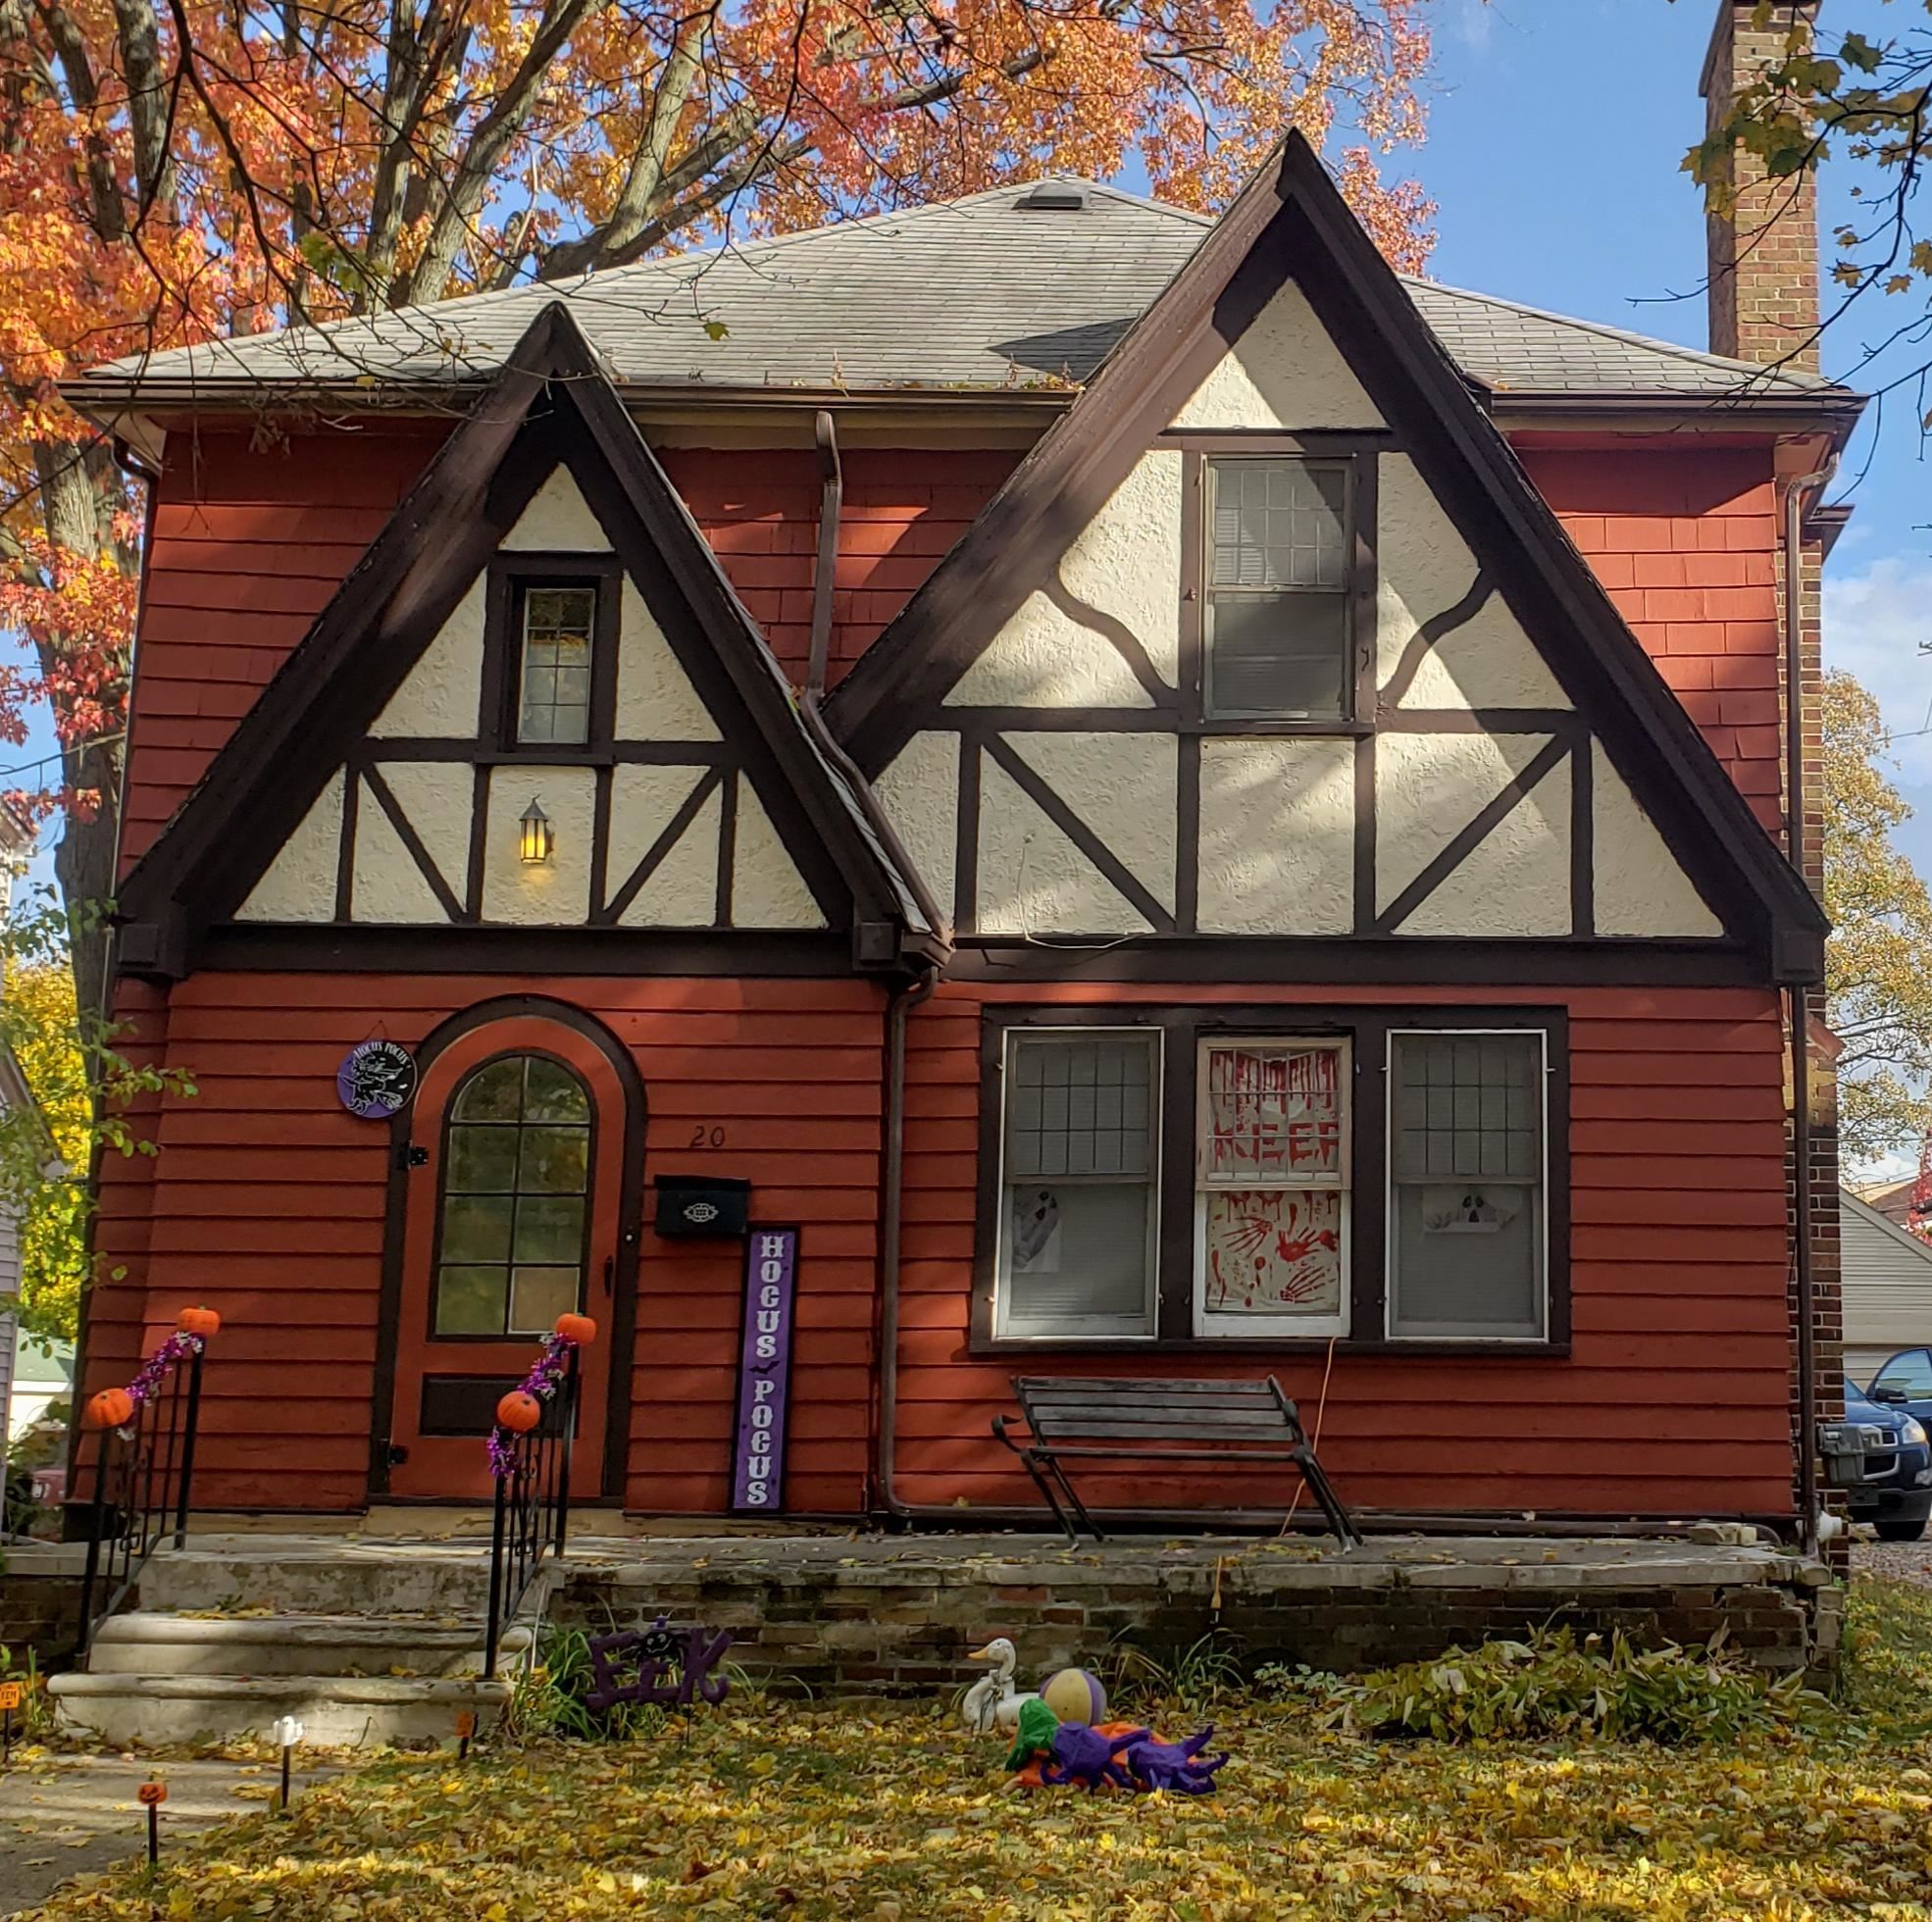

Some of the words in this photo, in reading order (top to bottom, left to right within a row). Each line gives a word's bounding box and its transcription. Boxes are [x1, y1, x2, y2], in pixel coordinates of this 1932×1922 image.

[353, 1041, 382, 1059] HOCUS
[383, 1042, 409, 1065] POCUS
[689, 1125, 726, 1148] 20
[755, 1236, 785, 1358] HOCUS
[746, 1380, 776, 1505] POCUS
